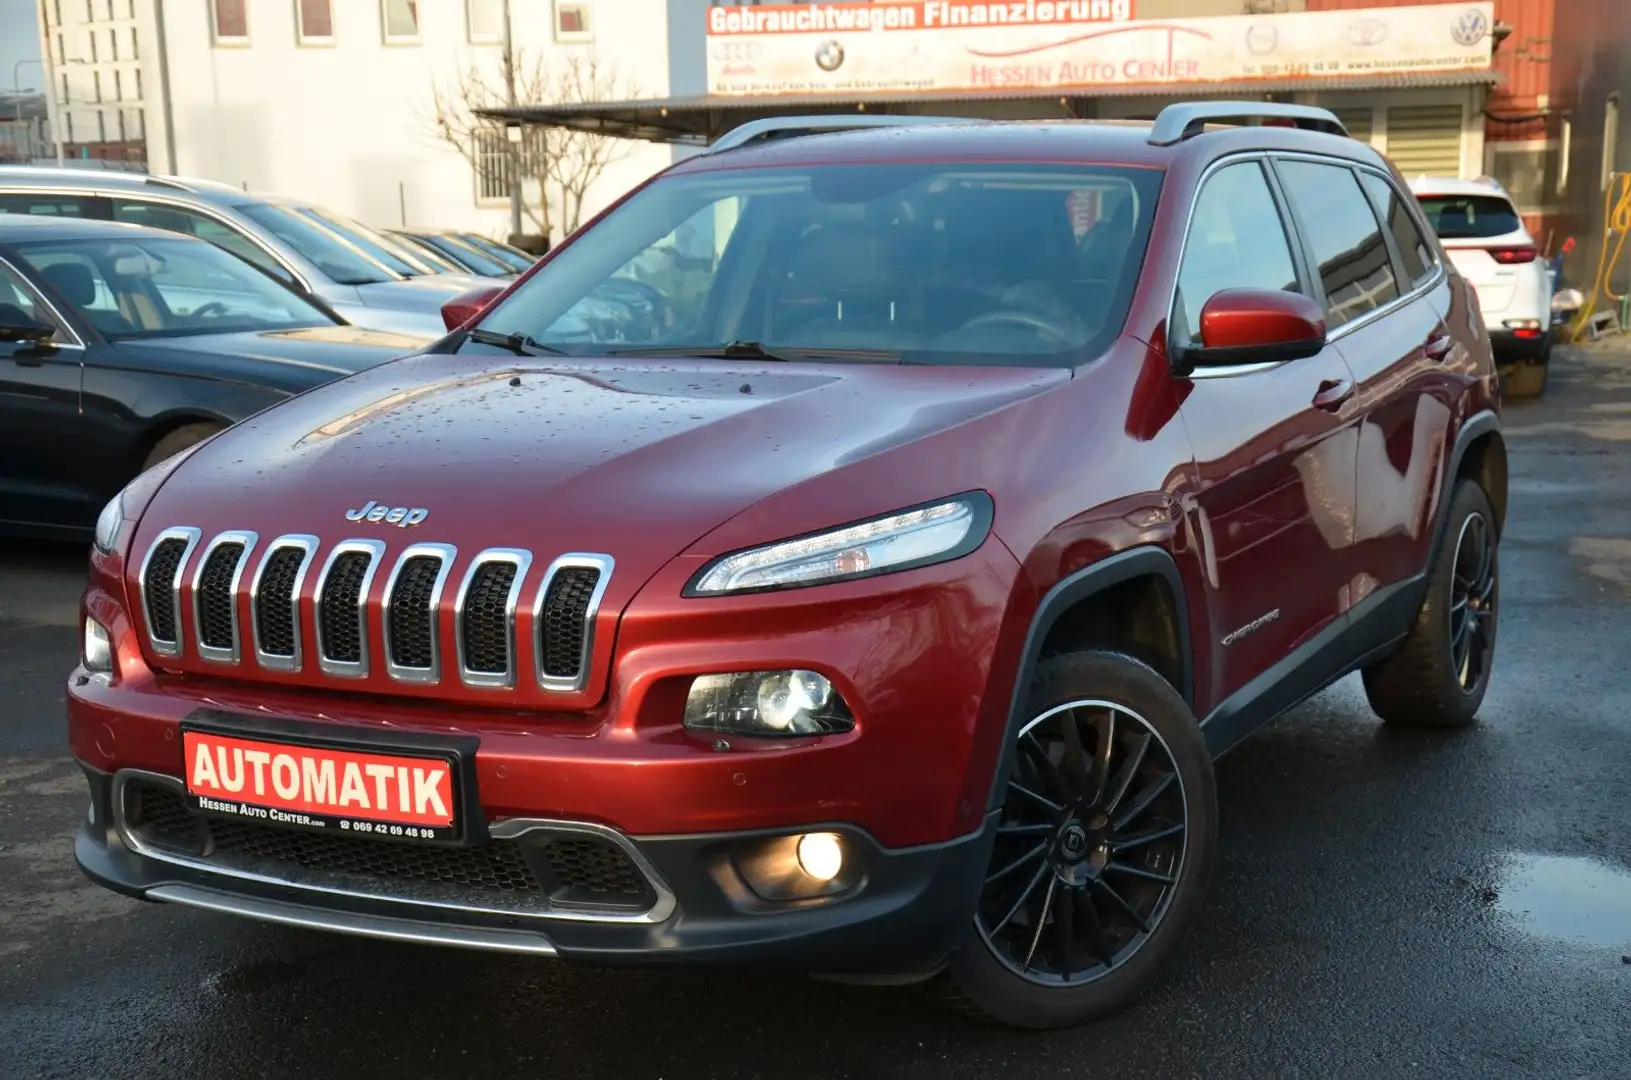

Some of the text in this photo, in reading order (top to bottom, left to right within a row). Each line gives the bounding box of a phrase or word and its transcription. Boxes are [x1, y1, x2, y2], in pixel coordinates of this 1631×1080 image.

[711, 0, 1129, 34] Gebrauchtwagen Finanzierung
[345, 500, 428, 528] Jeep
[193, 743, 448, 816] AUTOMATIK
[199, 796, 238, 813] HESSEN
[239, 803, 267, 818] AUTO
[353, 821, 435, 839] 069 42 69 48 98
